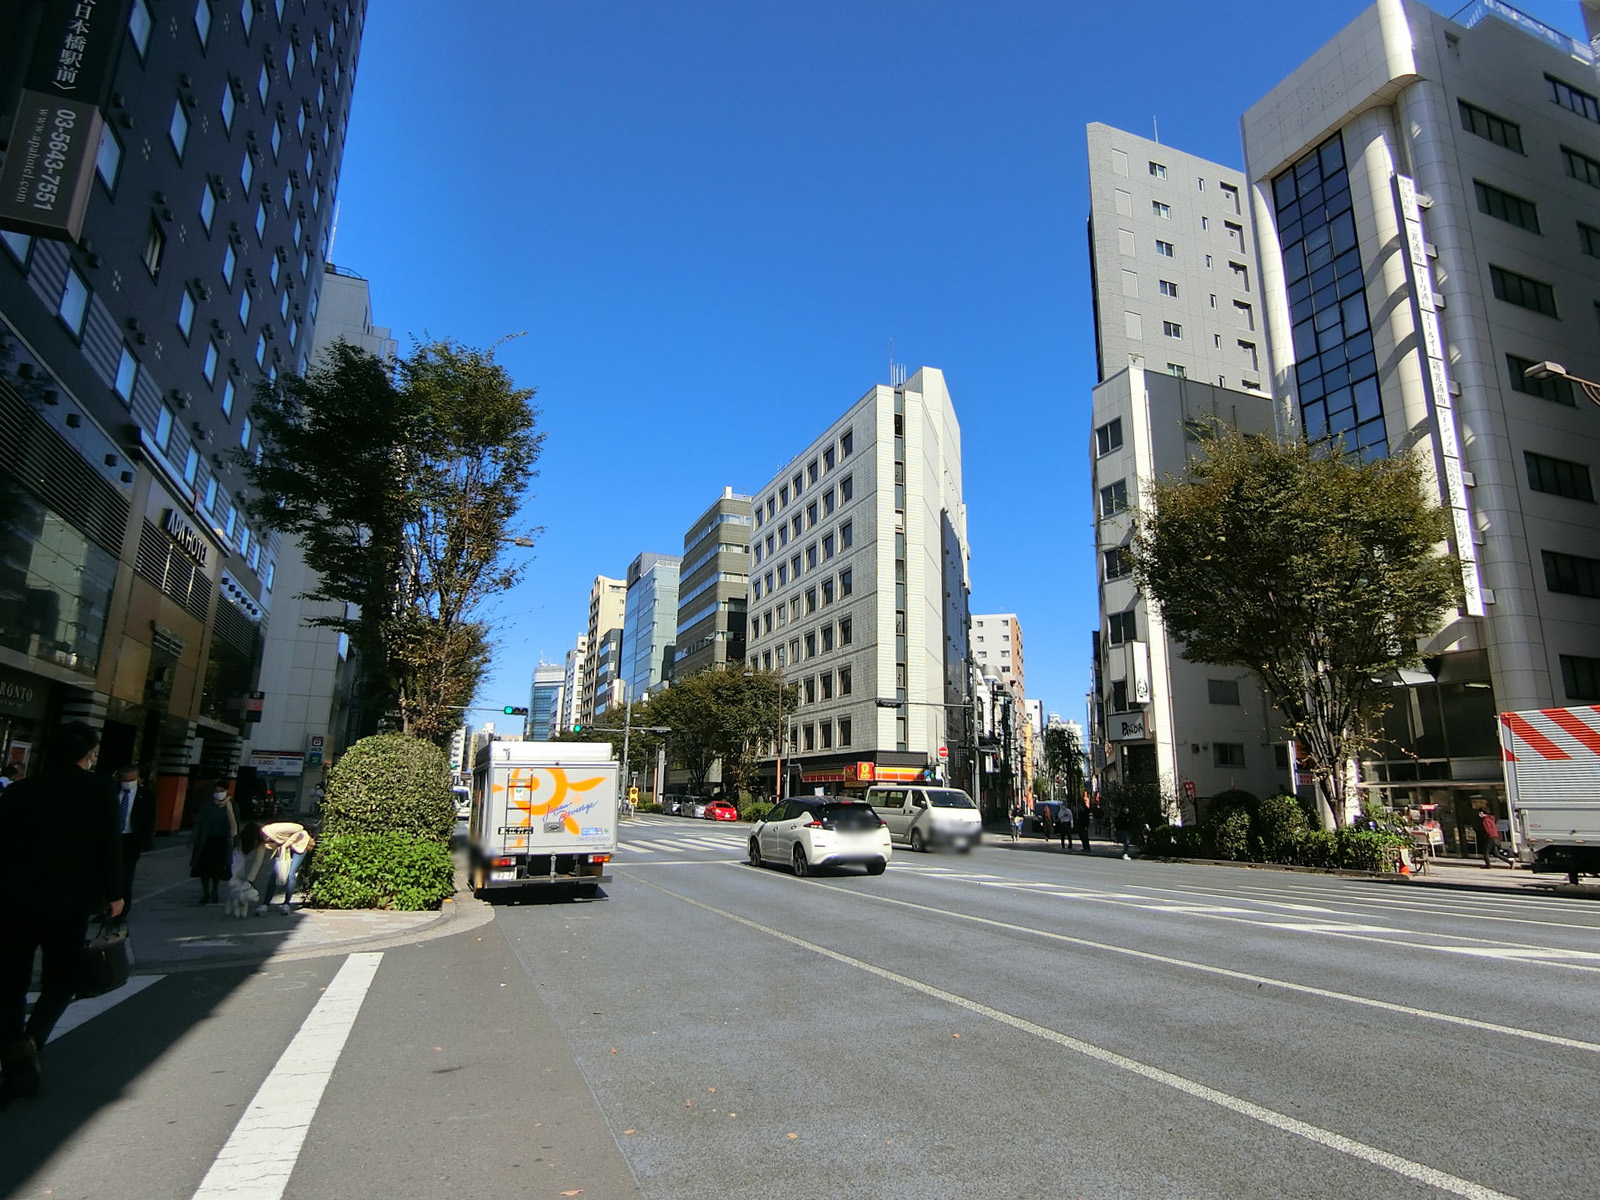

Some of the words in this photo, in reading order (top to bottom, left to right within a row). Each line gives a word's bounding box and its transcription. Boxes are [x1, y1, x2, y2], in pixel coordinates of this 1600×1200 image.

[53, 0, 97, 91] 日本橋駅前〉
[16, 108, 49, 204] www.apahotel.com
[33, 108, 76, 211] 03-5643-7551
[167, 510, 186, 545] APA
[184, 530, 207, 567] HOTEL
[1121, 721, 1144, 736] PANDA
[543, 802, 573, 823] Japan
